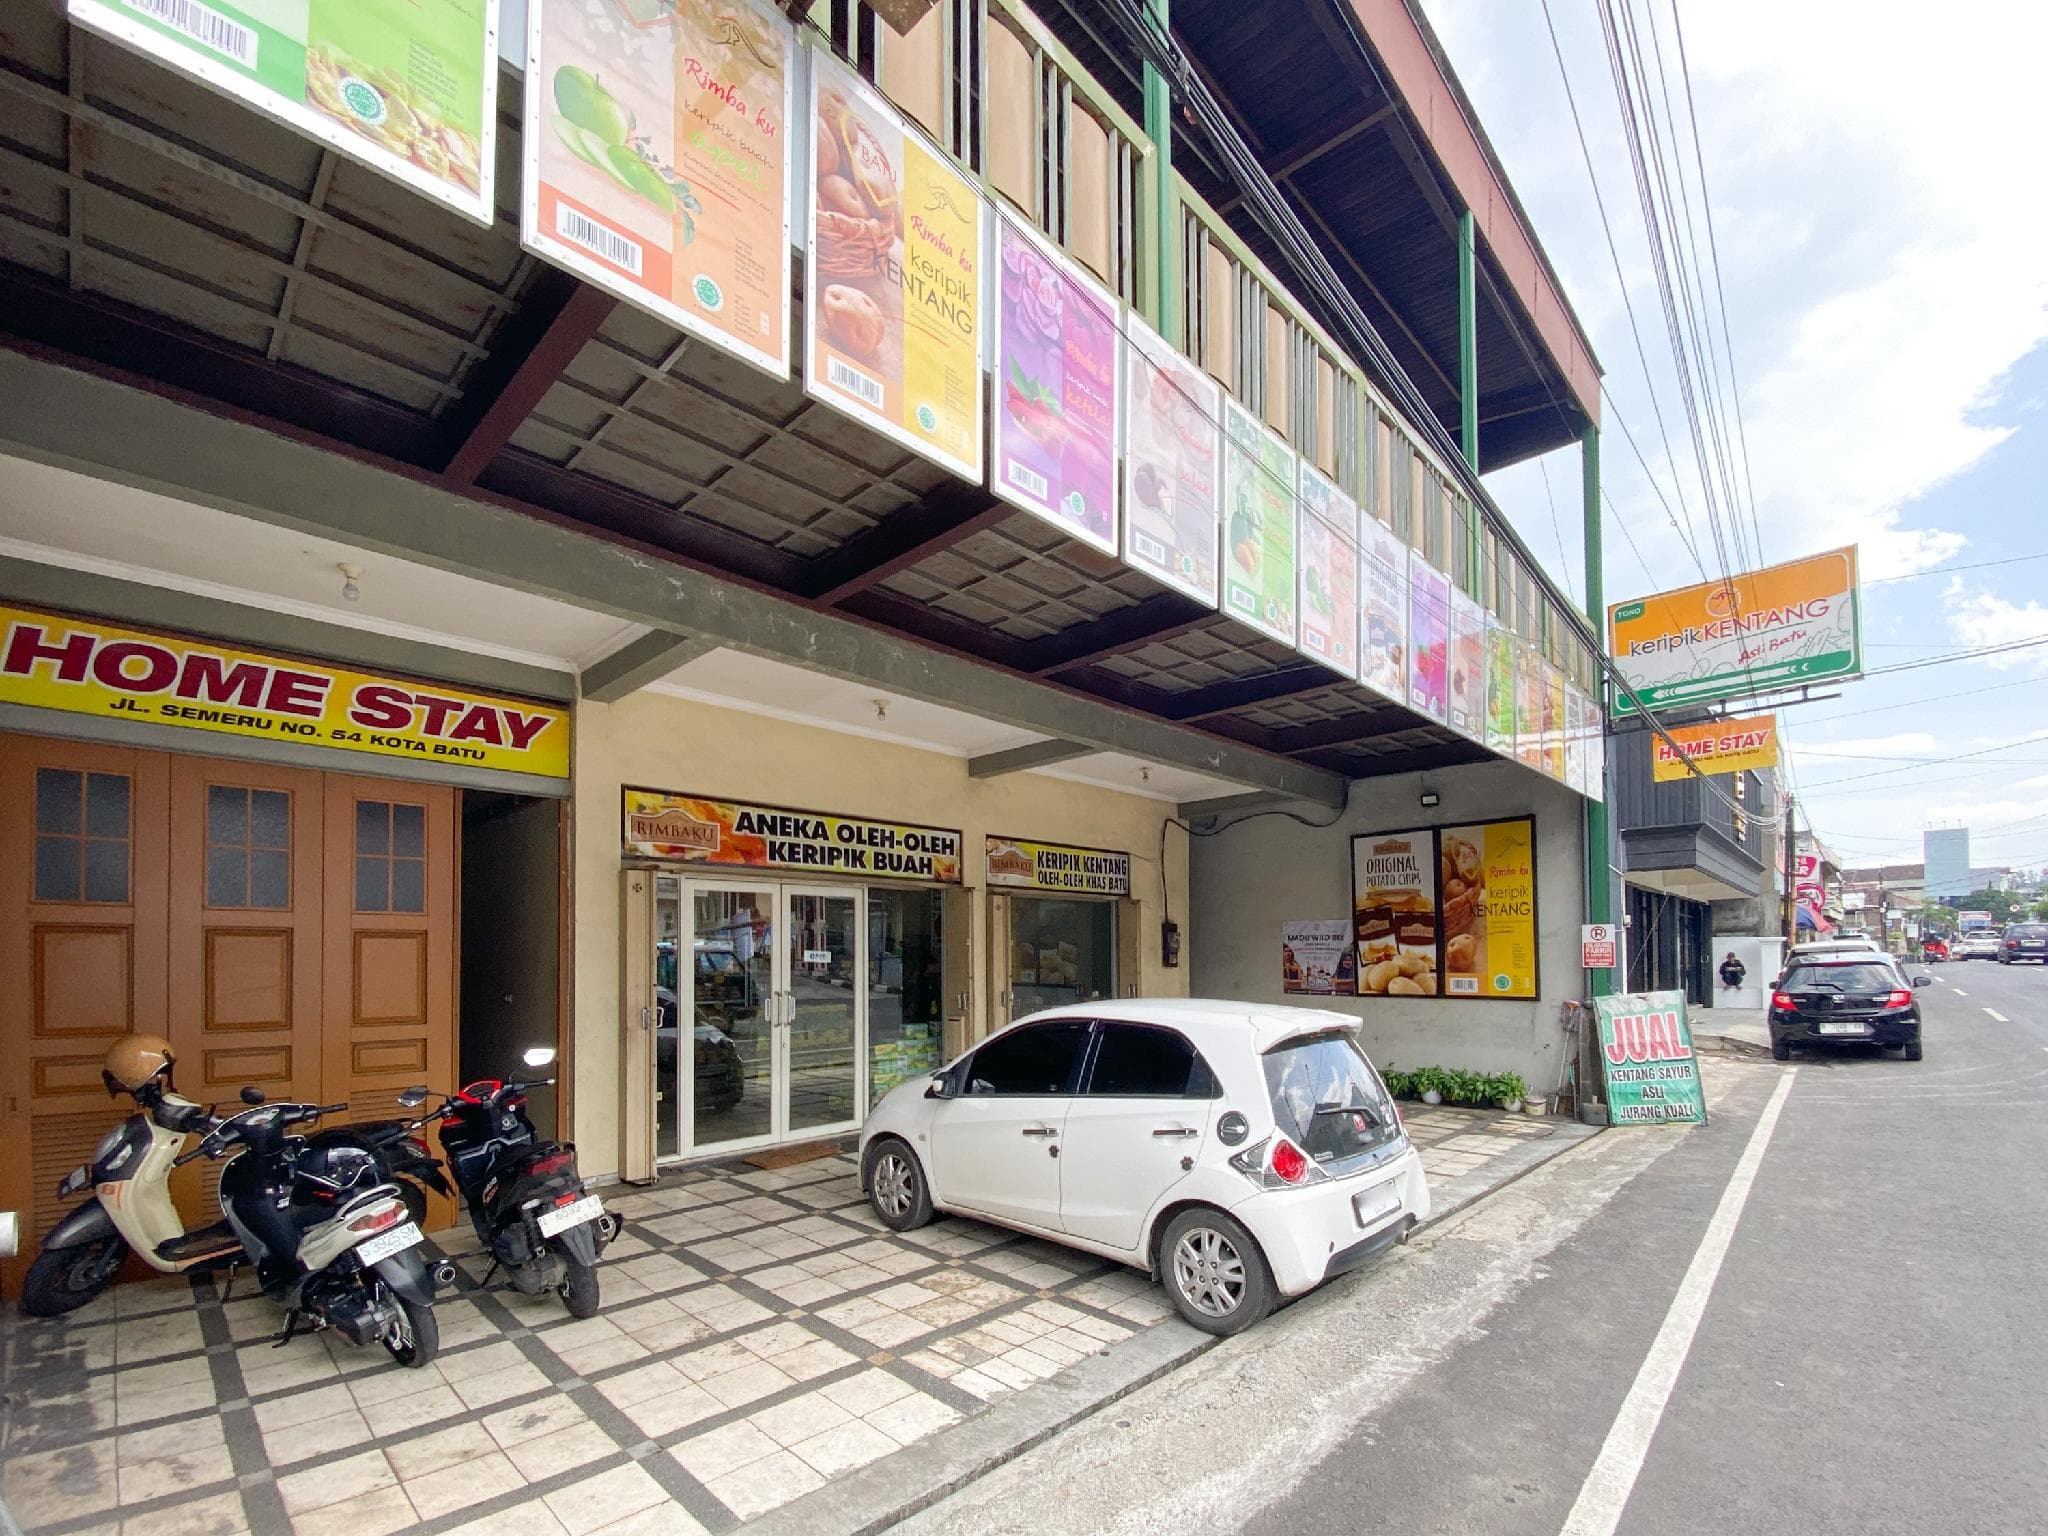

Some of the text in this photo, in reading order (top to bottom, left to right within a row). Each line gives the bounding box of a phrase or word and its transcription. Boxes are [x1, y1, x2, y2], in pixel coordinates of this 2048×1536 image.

[684, 57, 777, 138] Rimba ku
[911, 215, 973, 273] Rimba ku
[911, 245, 972, 308] keripik
[873, 253, 973, 335] KENTANG
[1617, 607, 1641, 618] TOKO
[1738, 643, 1766, 664] Asli
[3, 624, 552, 750] HOME STAY
[110, 698, 486, 760] JL. SEMERU NO. 54 KOTA BATU
[1659, 730, 1769, 761] HOME STAY
[637, 820, 713, 842] RIMBAKU
[734, 811, 955, 856] ANEKA OLEH-OLEH
[768, 840, 933, 875] KERIPIK BUAH
[1037, 850, 1127, 876] KERIPIK KENTANG
[1366, 856, 1420, 874] ORIGINAL
[1038, 870, 1127, 891] OLEH-OLEH KHAS BATU
[1366, 872, 1422, 888] POTATO CHIPS
[1489, 885, 1529, 901] keripik
[1469, 902, 1531, 918] KENTANG
[1606, 1012, 1692, 1064] JUAL
[1610, 1065, 1692, 1082] KENTANG SAYUR
[1642, 1085, 1664, 1099] ASLI
[1620, 1104, 1694, 1119] JURANG KUALI
